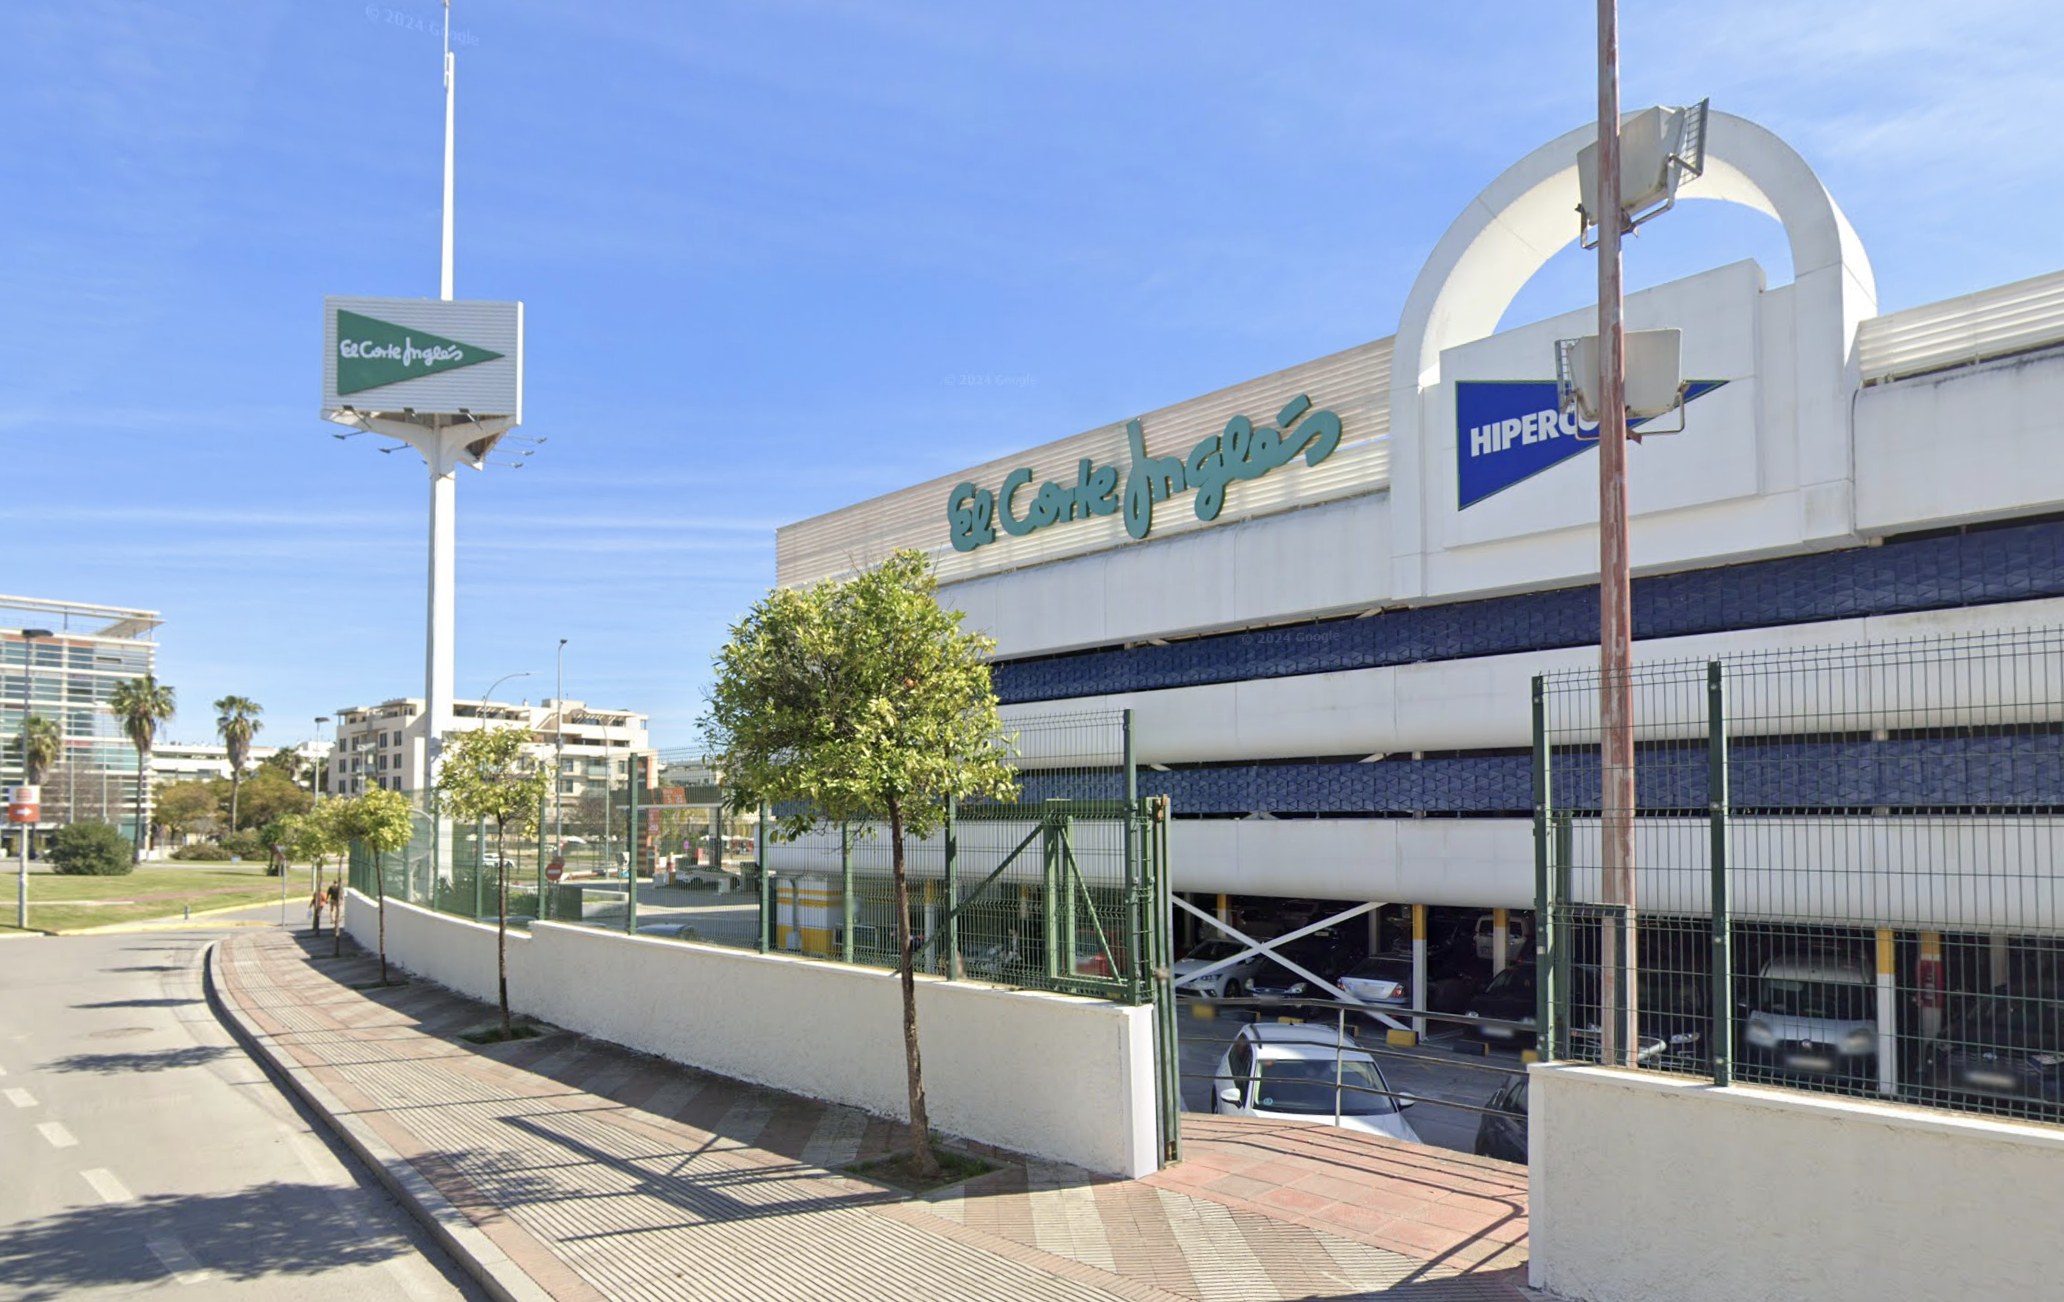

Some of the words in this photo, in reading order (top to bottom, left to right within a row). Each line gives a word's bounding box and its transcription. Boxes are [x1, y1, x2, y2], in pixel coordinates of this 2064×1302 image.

[340, 339, 359, 359] El
[359, 340, 402, 360] Corte
[402, 337, 463, 367] Inglés
[948, 482, 996, 552] El
[998, 457, 1119, 537] Corte
[1123, 393, 1342, 539] Inglés
